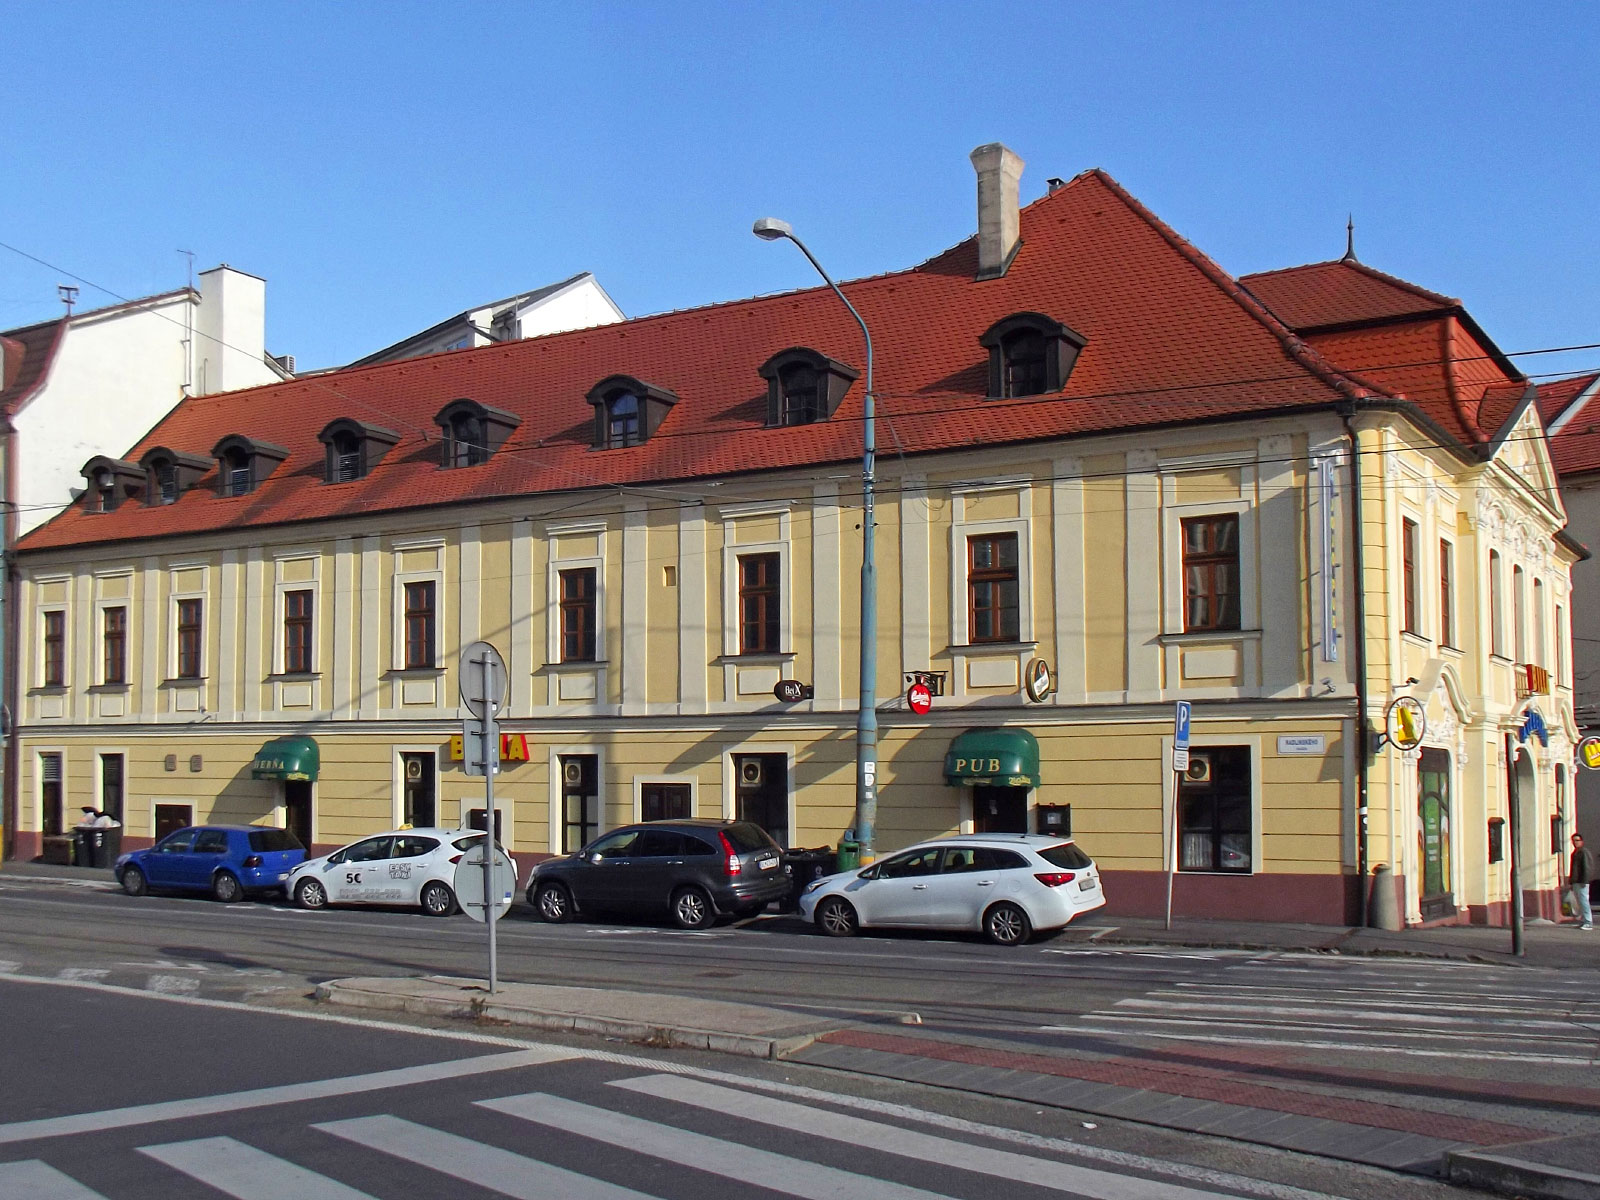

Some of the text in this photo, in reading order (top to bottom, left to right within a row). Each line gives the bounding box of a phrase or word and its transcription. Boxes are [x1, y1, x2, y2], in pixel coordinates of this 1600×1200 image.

[1180, 705, 1188, 731] P
[450, 733, 530, 761] BLA
[955, 758, 1000, 772] PUB
[389, 863, 412, 872] EASY
[390, 871, 412, 880] TAXI
